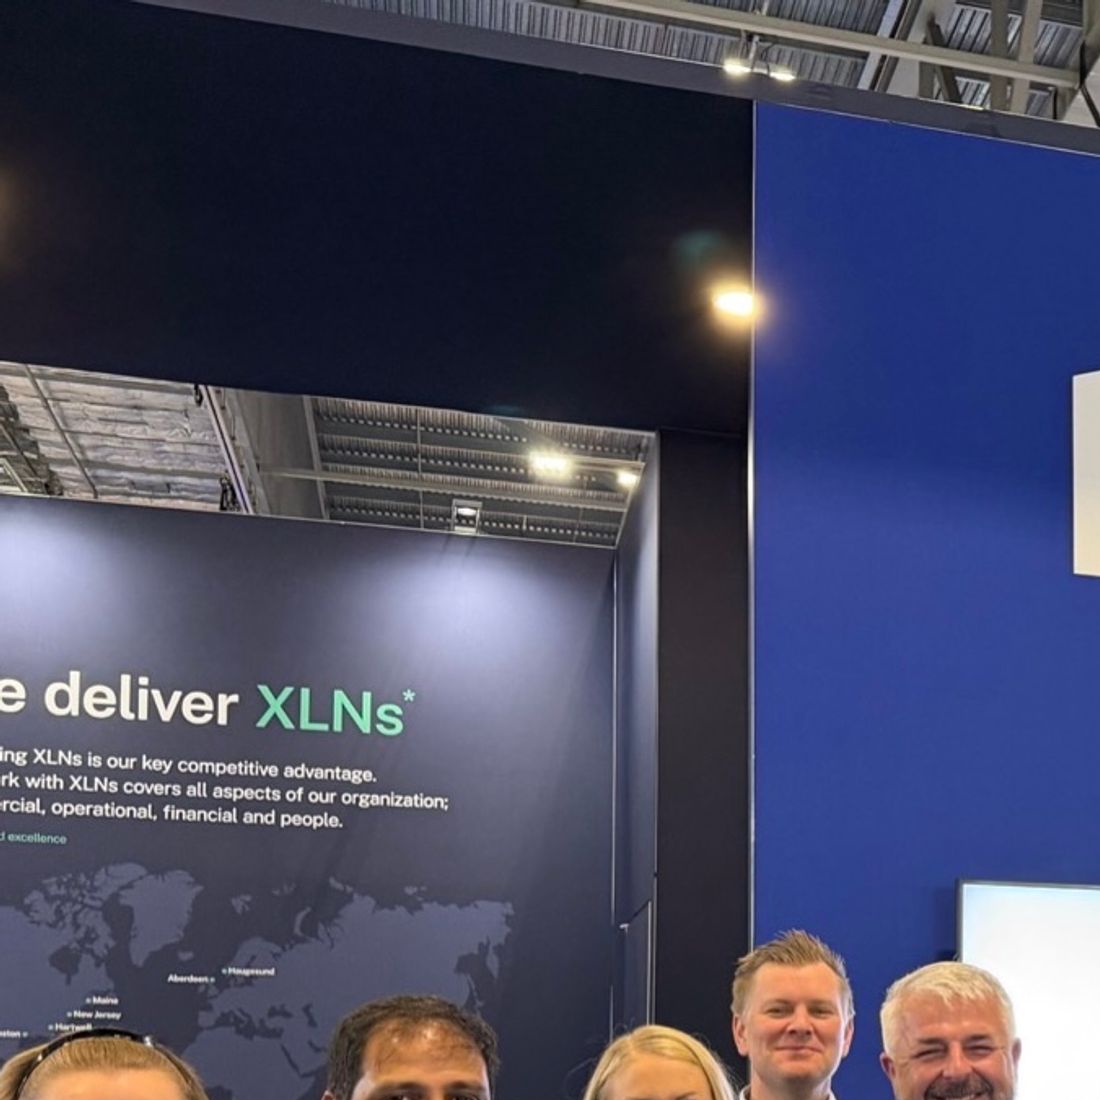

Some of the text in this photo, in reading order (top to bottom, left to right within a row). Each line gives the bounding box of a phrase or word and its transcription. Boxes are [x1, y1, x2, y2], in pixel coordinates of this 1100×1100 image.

[44, 670, 239, 726] deliver
[33, 748, 82, 767] XLNs
[87, 750, 102, 768] is
[107, 756, 137, 770] our
[141, 753, 172, 774] key
[177, 756, 279, 778] competitive
[283, 762, 377, 784] advantage.
[25, 773, 64, 791] with
[69, 775, 118, 794] XLNs
[123, 781, 181, 797] covers
[186, 781, 207, 798] all
[212, 784, 281, 803] aspects
[285, 785, 303, 802] of
[308, 789, 337, 804] our
[341, 789, 449, 811] organization;
[51, 800, 158, 822] operational,
[163, 804, 238, 825] financial
[243, 808, 275, 826] and
[280, 810, 343, 831] people.
[8, 832, 67, 845] excellence
[167, 974, 209, 984] Aberdeen
[93, 996, 119, 1005] Maine
[73, 1010, 121, 1021] New Jersey
